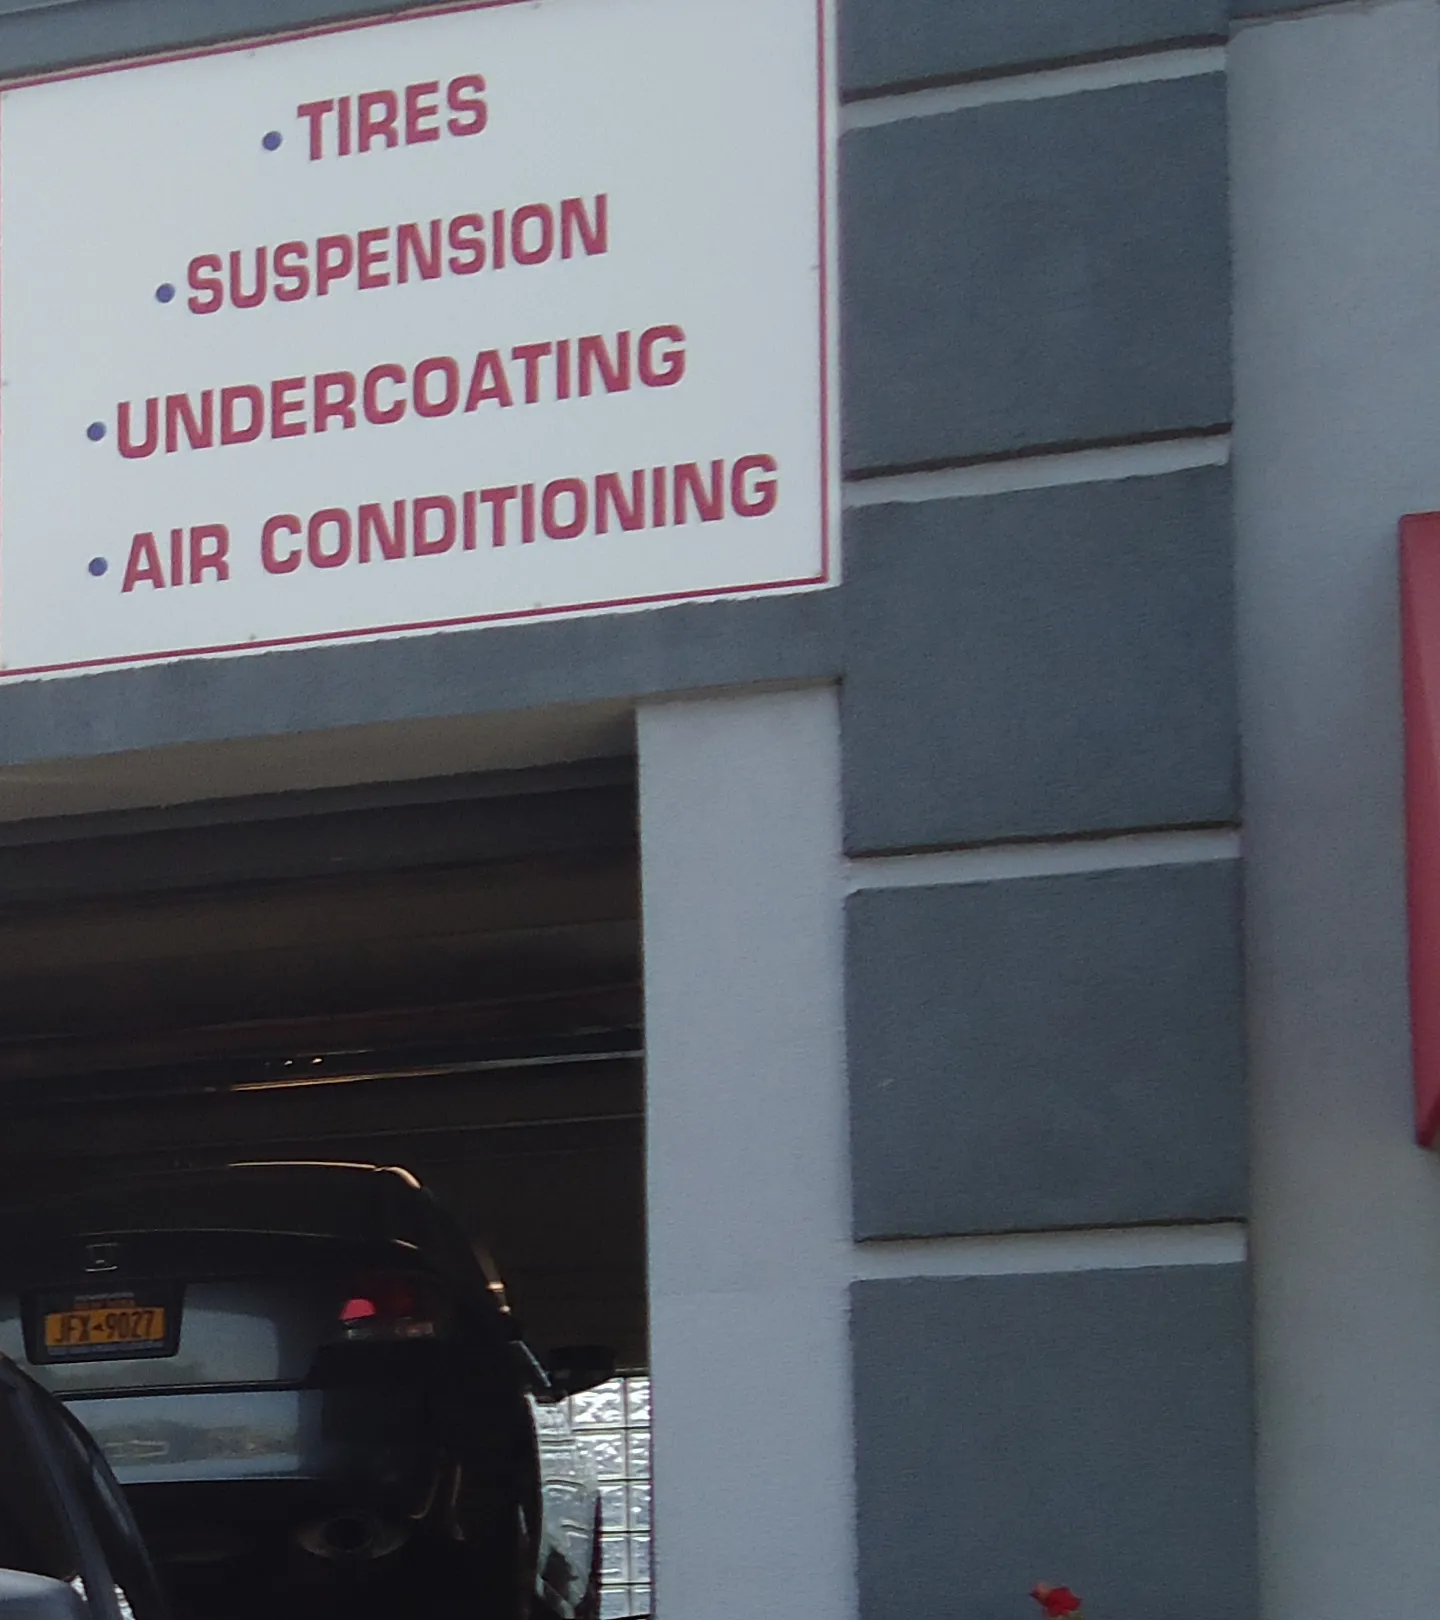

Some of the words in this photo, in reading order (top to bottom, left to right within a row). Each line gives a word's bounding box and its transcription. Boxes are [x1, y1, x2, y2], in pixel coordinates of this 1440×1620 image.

[297, 73, 488, 162] TIRES
[186, 193, 609, 314] SUSPENSION
[117, 323, 687, 460] UNDERCOATING
[121, 523, 231, 594] AIR
[260, 453, 779, 577] CONDITIONING
